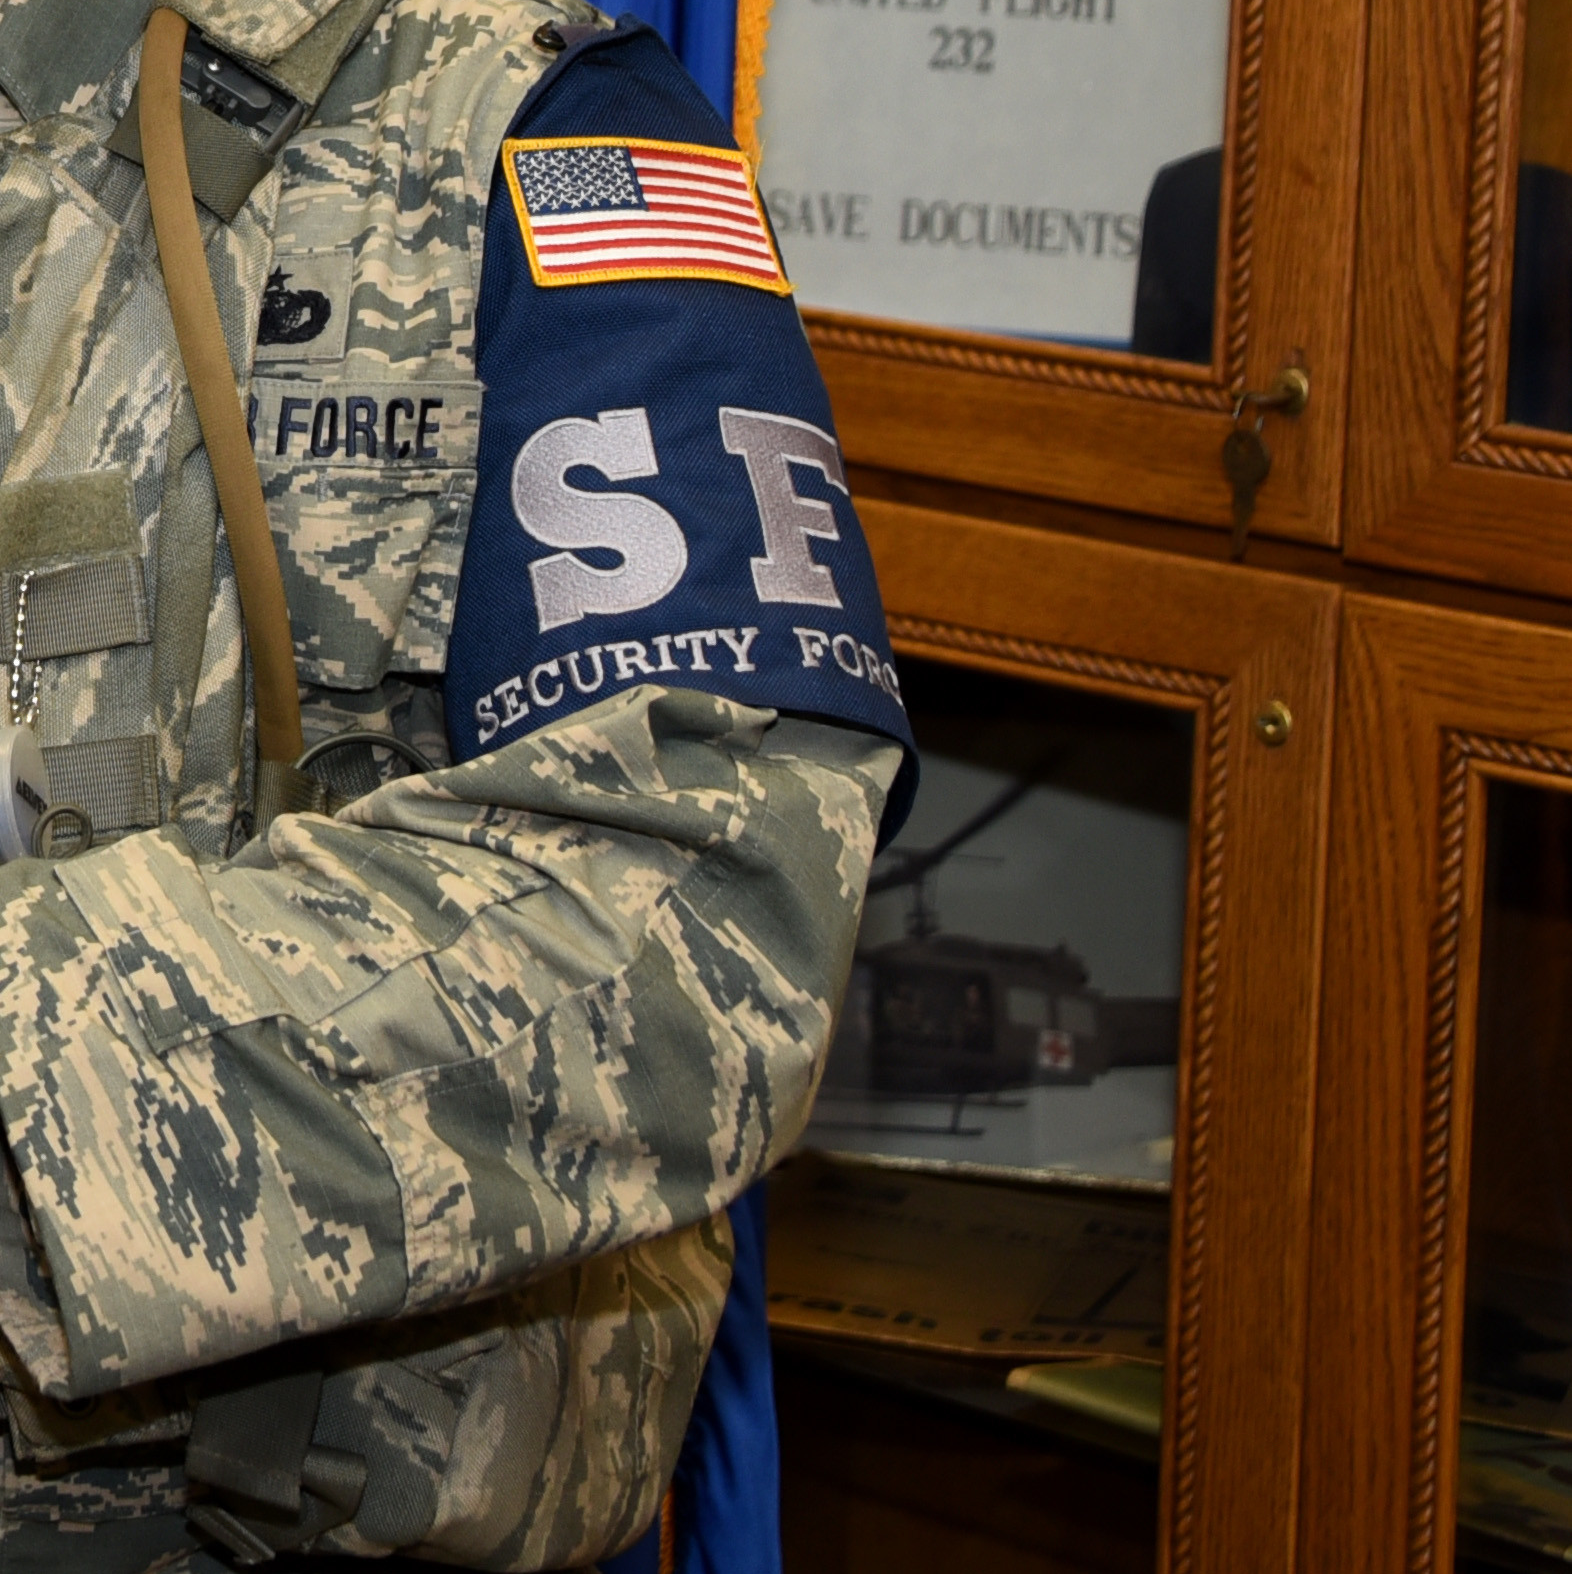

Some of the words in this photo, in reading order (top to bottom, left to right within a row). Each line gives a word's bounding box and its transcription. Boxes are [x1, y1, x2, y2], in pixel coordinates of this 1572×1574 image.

[929, 28, 995, 73] 232
[769, 190, 869, 241] SAVE
[900, 198, 1138, 257] DOCUMENTS
[276, 396, 443, 459] FORCE
[474, 625, 761, 744] SECURITY
[793, 627, 904, 709] FORC
